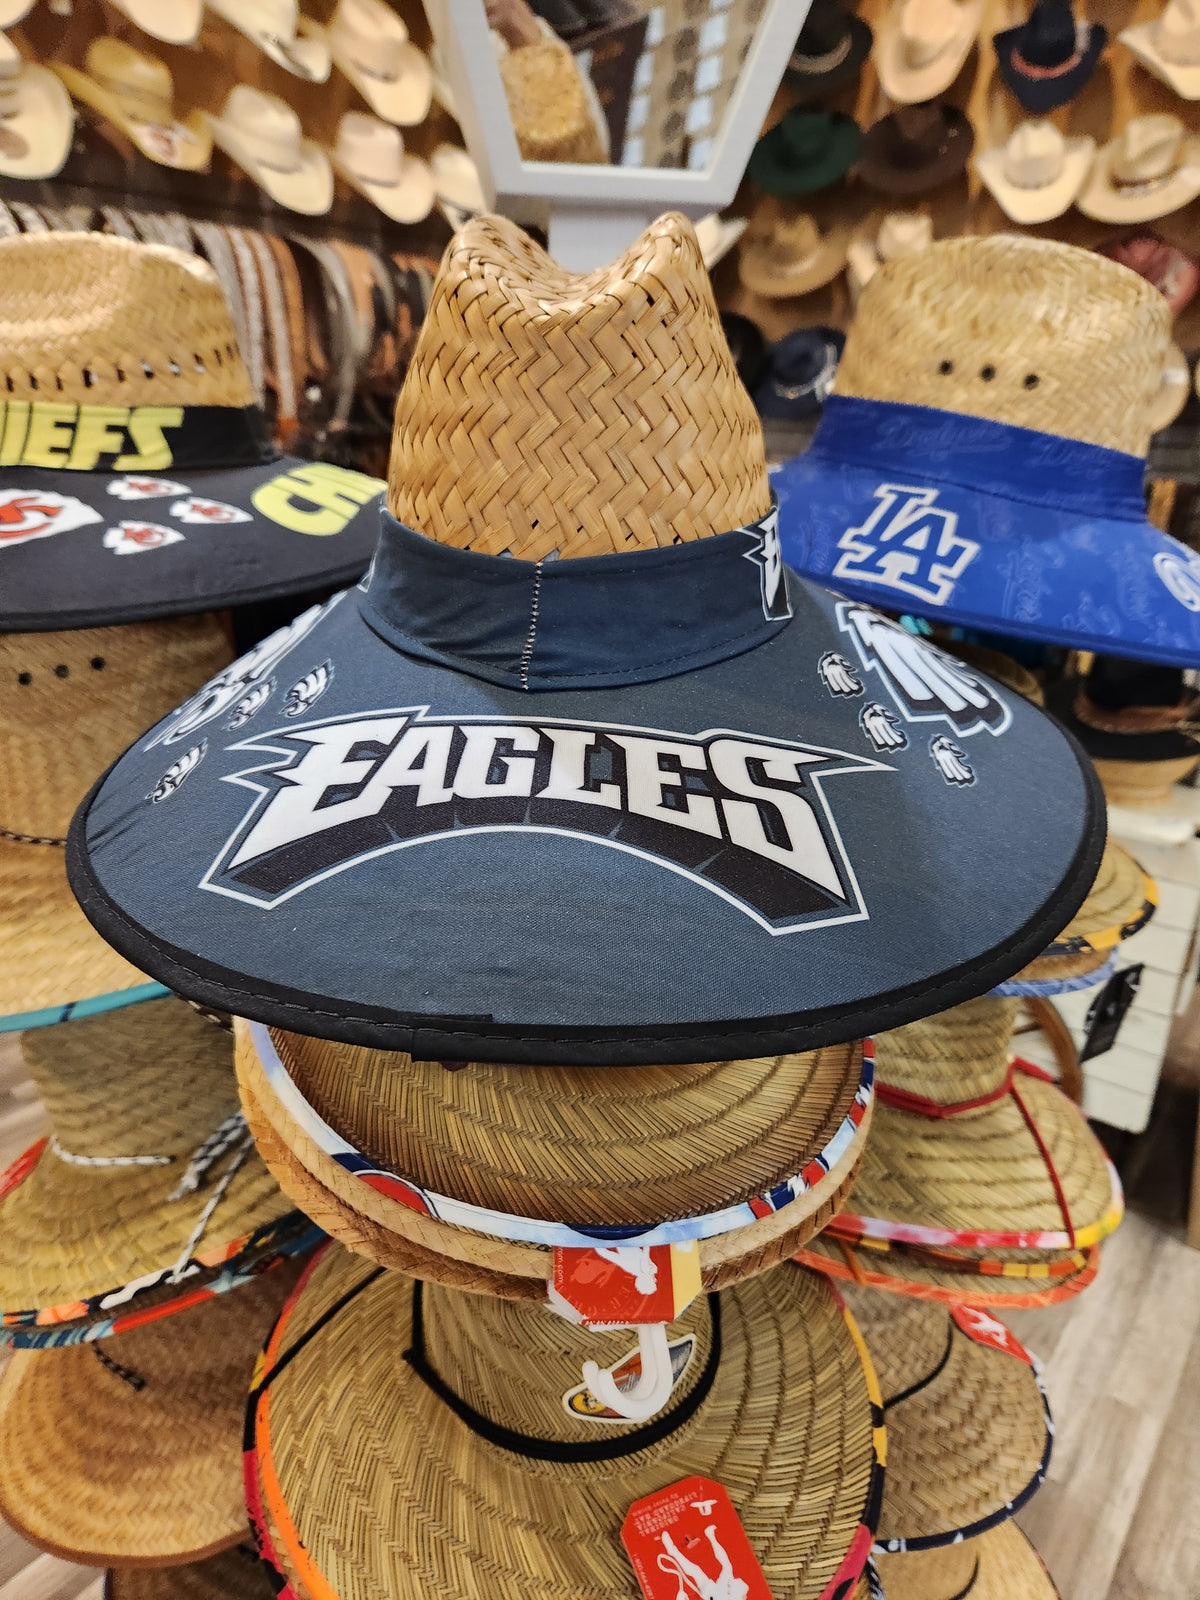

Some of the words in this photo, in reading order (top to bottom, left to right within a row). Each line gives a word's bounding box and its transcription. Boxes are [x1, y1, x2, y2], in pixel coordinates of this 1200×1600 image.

[0, 400, 184, 471] IEFS
[833, 484, 981, 606] LA
[225, 713, 850, 903] EAGLES
